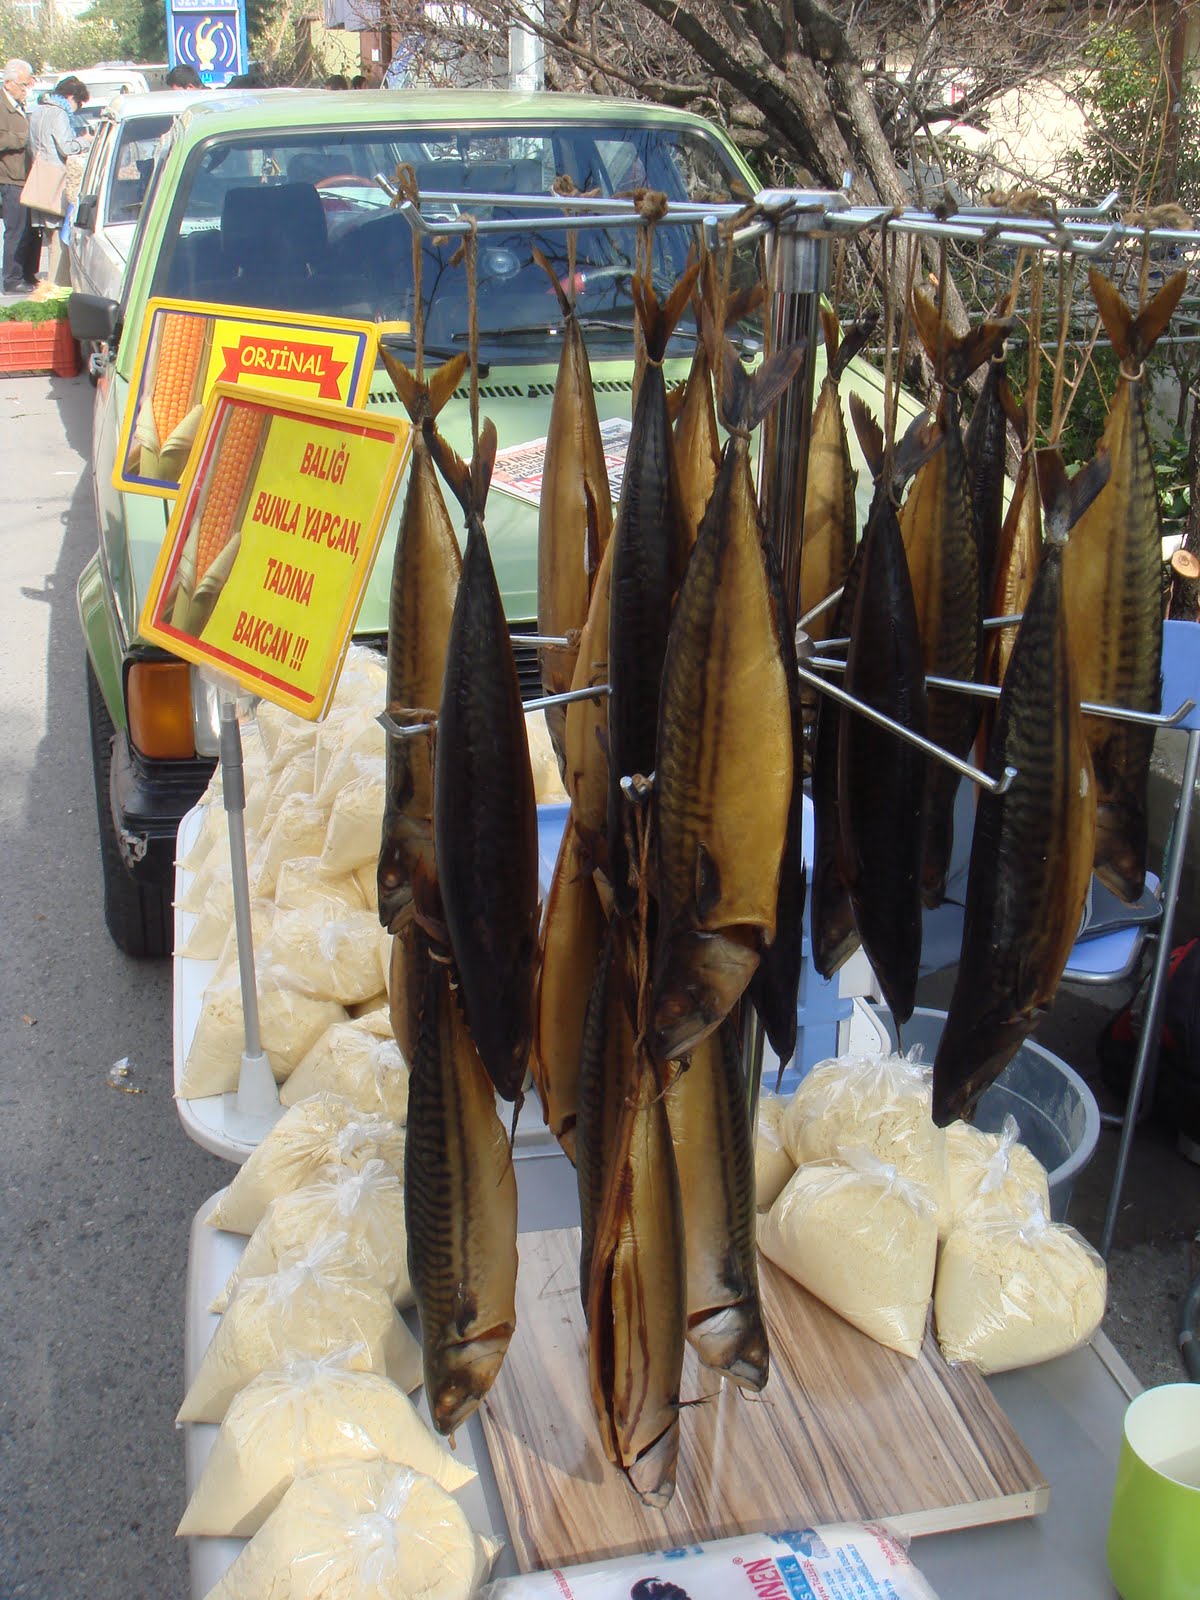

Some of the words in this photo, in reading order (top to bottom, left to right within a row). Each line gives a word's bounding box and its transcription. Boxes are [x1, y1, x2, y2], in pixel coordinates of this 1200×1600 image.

[241, 345, 326, 376] ORJİNAL
[299, 442, 351, 485] BALIĞI
[251, 491, 302, 535] BUNLA
[302, 506, 362, 565] YAPCAN,
[263, 557, 315, 607] TADINA
[232, 610, 294, 664] BAKCAN
